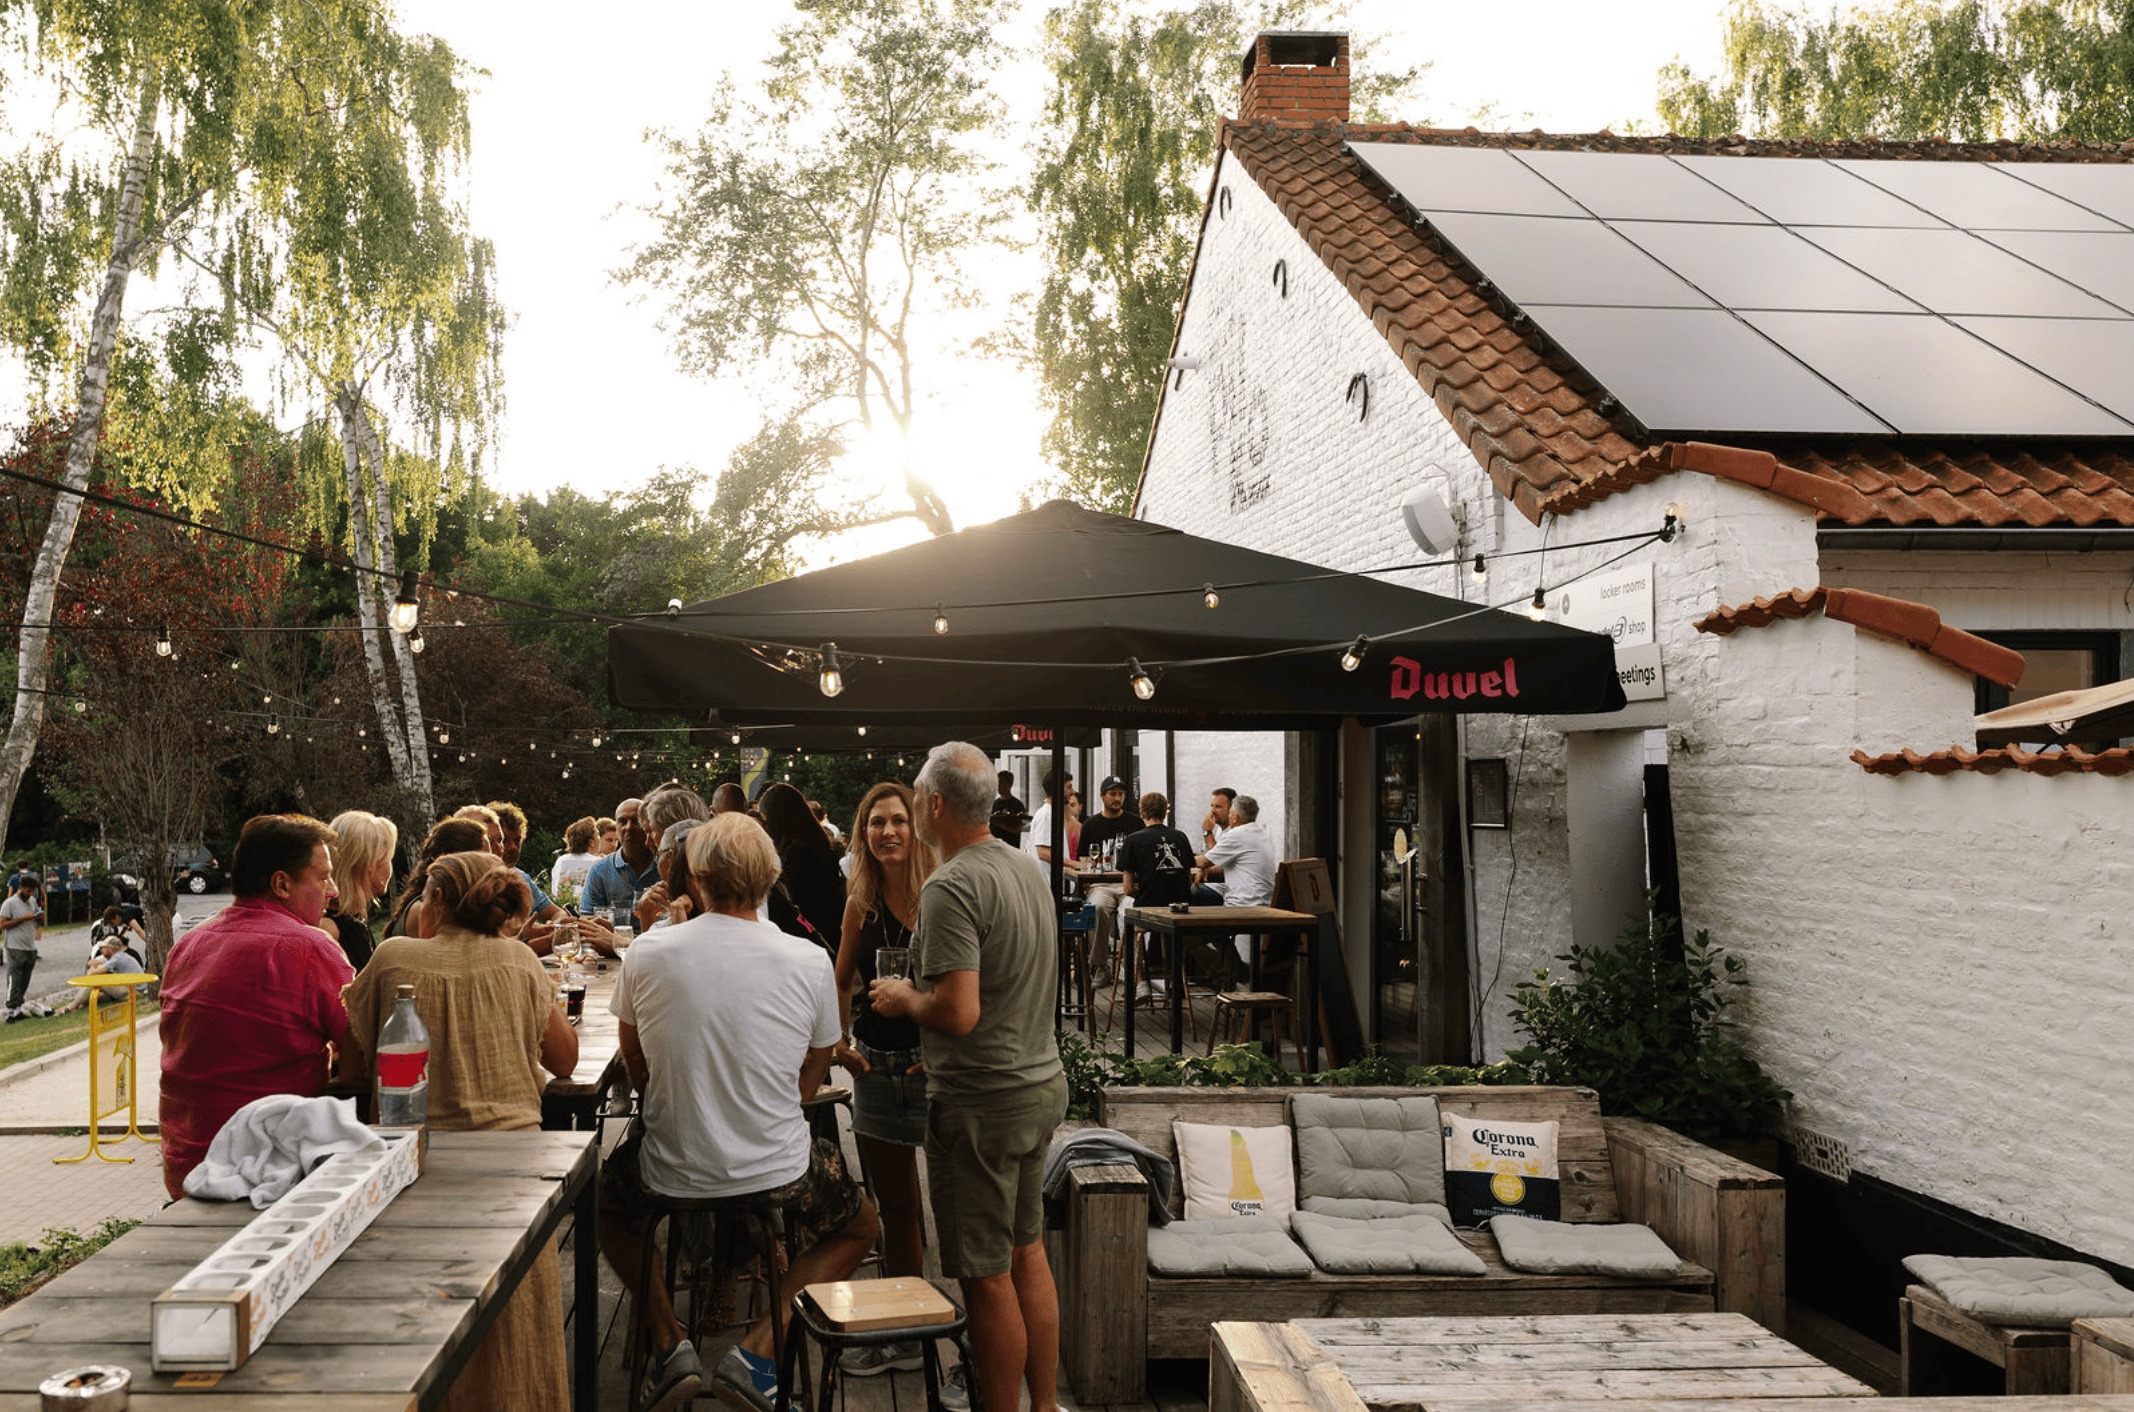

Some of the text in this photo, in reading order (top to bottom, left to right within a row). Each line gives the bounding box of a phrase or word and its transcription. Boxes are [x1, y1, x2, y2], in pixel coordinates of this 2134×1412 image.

[1601, 579, 1645, 599] locker rooms
[1628, 620, 1646, 635] shop
[1389, 656, 1520, 700] Duvel
[1012, 724, 1053, 742] Duv
[1472, 1128, 1536, 1147] Corona
[1491, 1144, 1525, 1158] Extra
[1231, 1201, 1261, 1211] Corona
